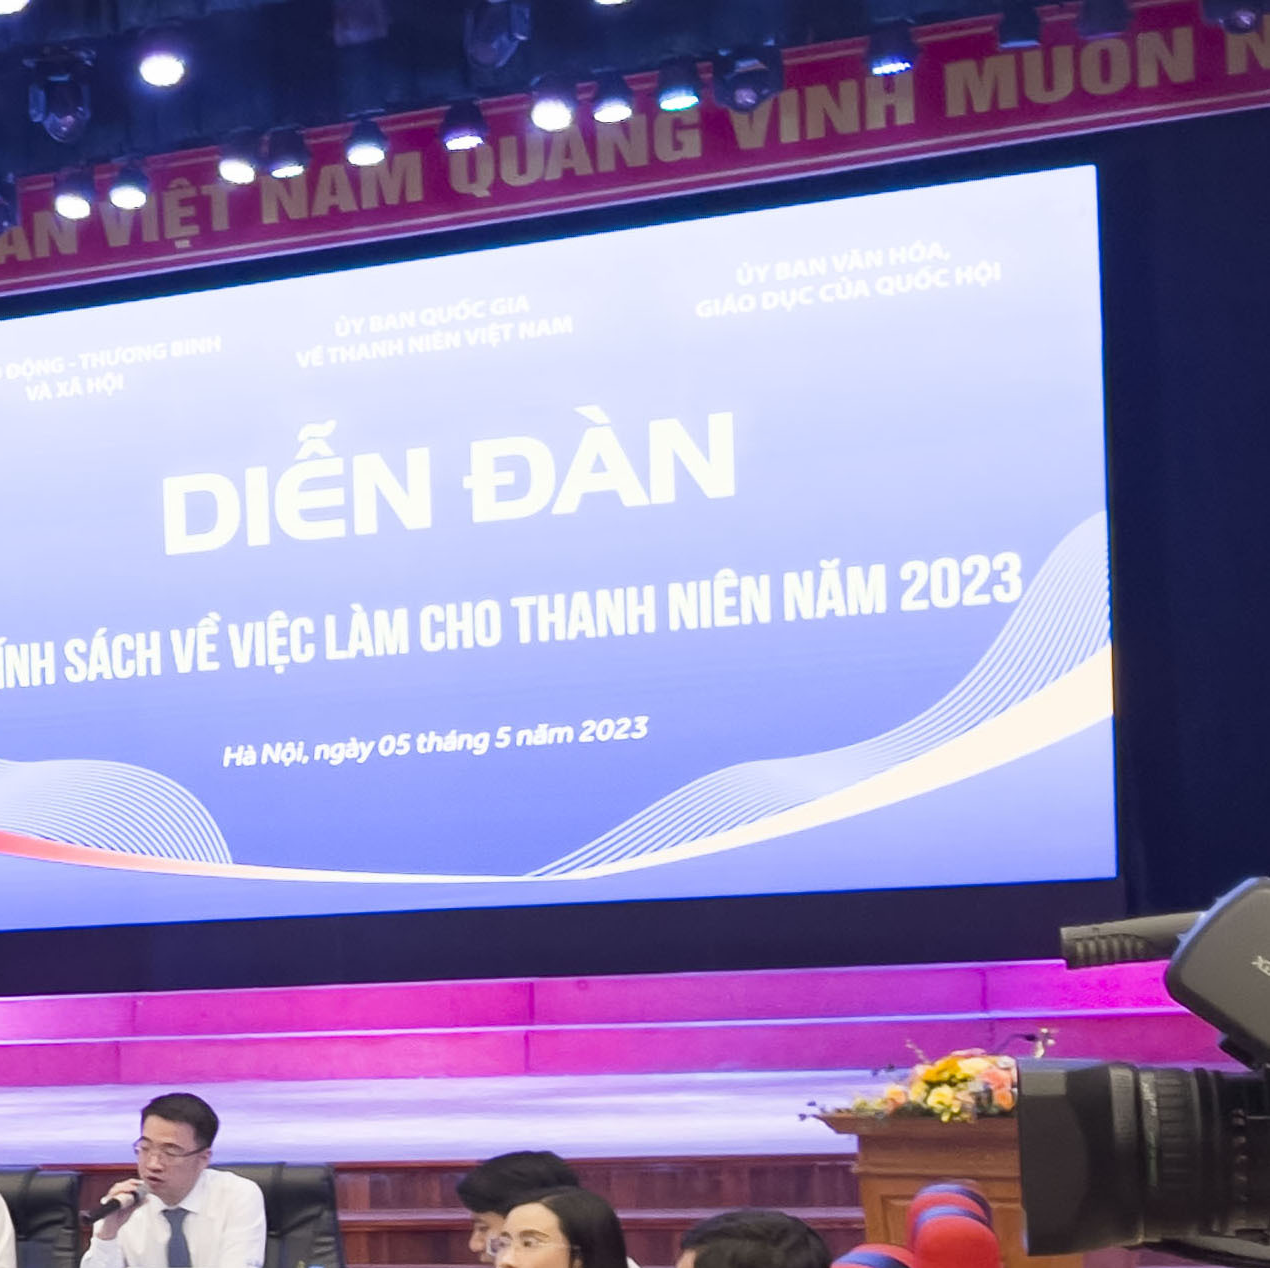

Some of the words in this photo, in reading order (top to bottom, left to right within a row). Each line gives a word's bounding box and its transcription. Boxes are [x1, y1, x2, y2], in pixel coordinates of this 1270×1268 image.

[99, 177, 232, 248] VIỆT
[262, 151, 423, 225] NAM
[448, 107, 702, 197] QUANG
[729, 74, 916, 150] VINH
[695, 292, 756, 318] GIÁO
[761, 286, 814, 312] DỤC
[819, 276, 870, 303] CỦA
[875, 266, 949, 296] QUỐC
[955, 261, 1002, 287] HỘI
[776, 258, 827, 280] BAN
[832, 249, 883, 272] VĂN
[328, 339, 404, 363] THANH
[409, 327, 460, 353] NIÊN
[463, 322, 514, 346] VIỆT
[519, 315, 573, 339] NAM
[369, 311, 415, 333] BAN
[420, 298, 485, 327] QUỐC
[490, 295, 529, 315] GIA
[6, 356, 64, 379] ĐỘNG
[79, 343, 166, 370] THƯƠNG
[171, 335, 222, 357] BINH
[25, 381, 53, 402] VÀ
[87, 372, 124, 397] HỘI
[162, 420, 432, 556] DIỄN
[462, 404, 735, 523] ĐÀN
[63, 627, 162, 683] SÁCH
[170, 611, 219, 673] VỀ
[228, 610, 316, 675] VIỆC
[324, 603, 409, 661] LÀM
[419, 599, 502, 653] CHO
[510, 584, 656, 644] THANH
[668, 567, 771, 631] NIÊN
[783, 557, 887, 621] NĂM
[900, 550, 1023, 612] 2023
[222, 745, 257, 768] Hà
[261, 741, 309, 767] Nội,
[314, 735, 376, 766] ngày
[378, 733, 410, 756] 05
[416, 729, 491, 756] tháng
[495, 726, 511, 749] 5
[515, 722, 575, 747] năm
[578, 715, 649, 744] 2023
